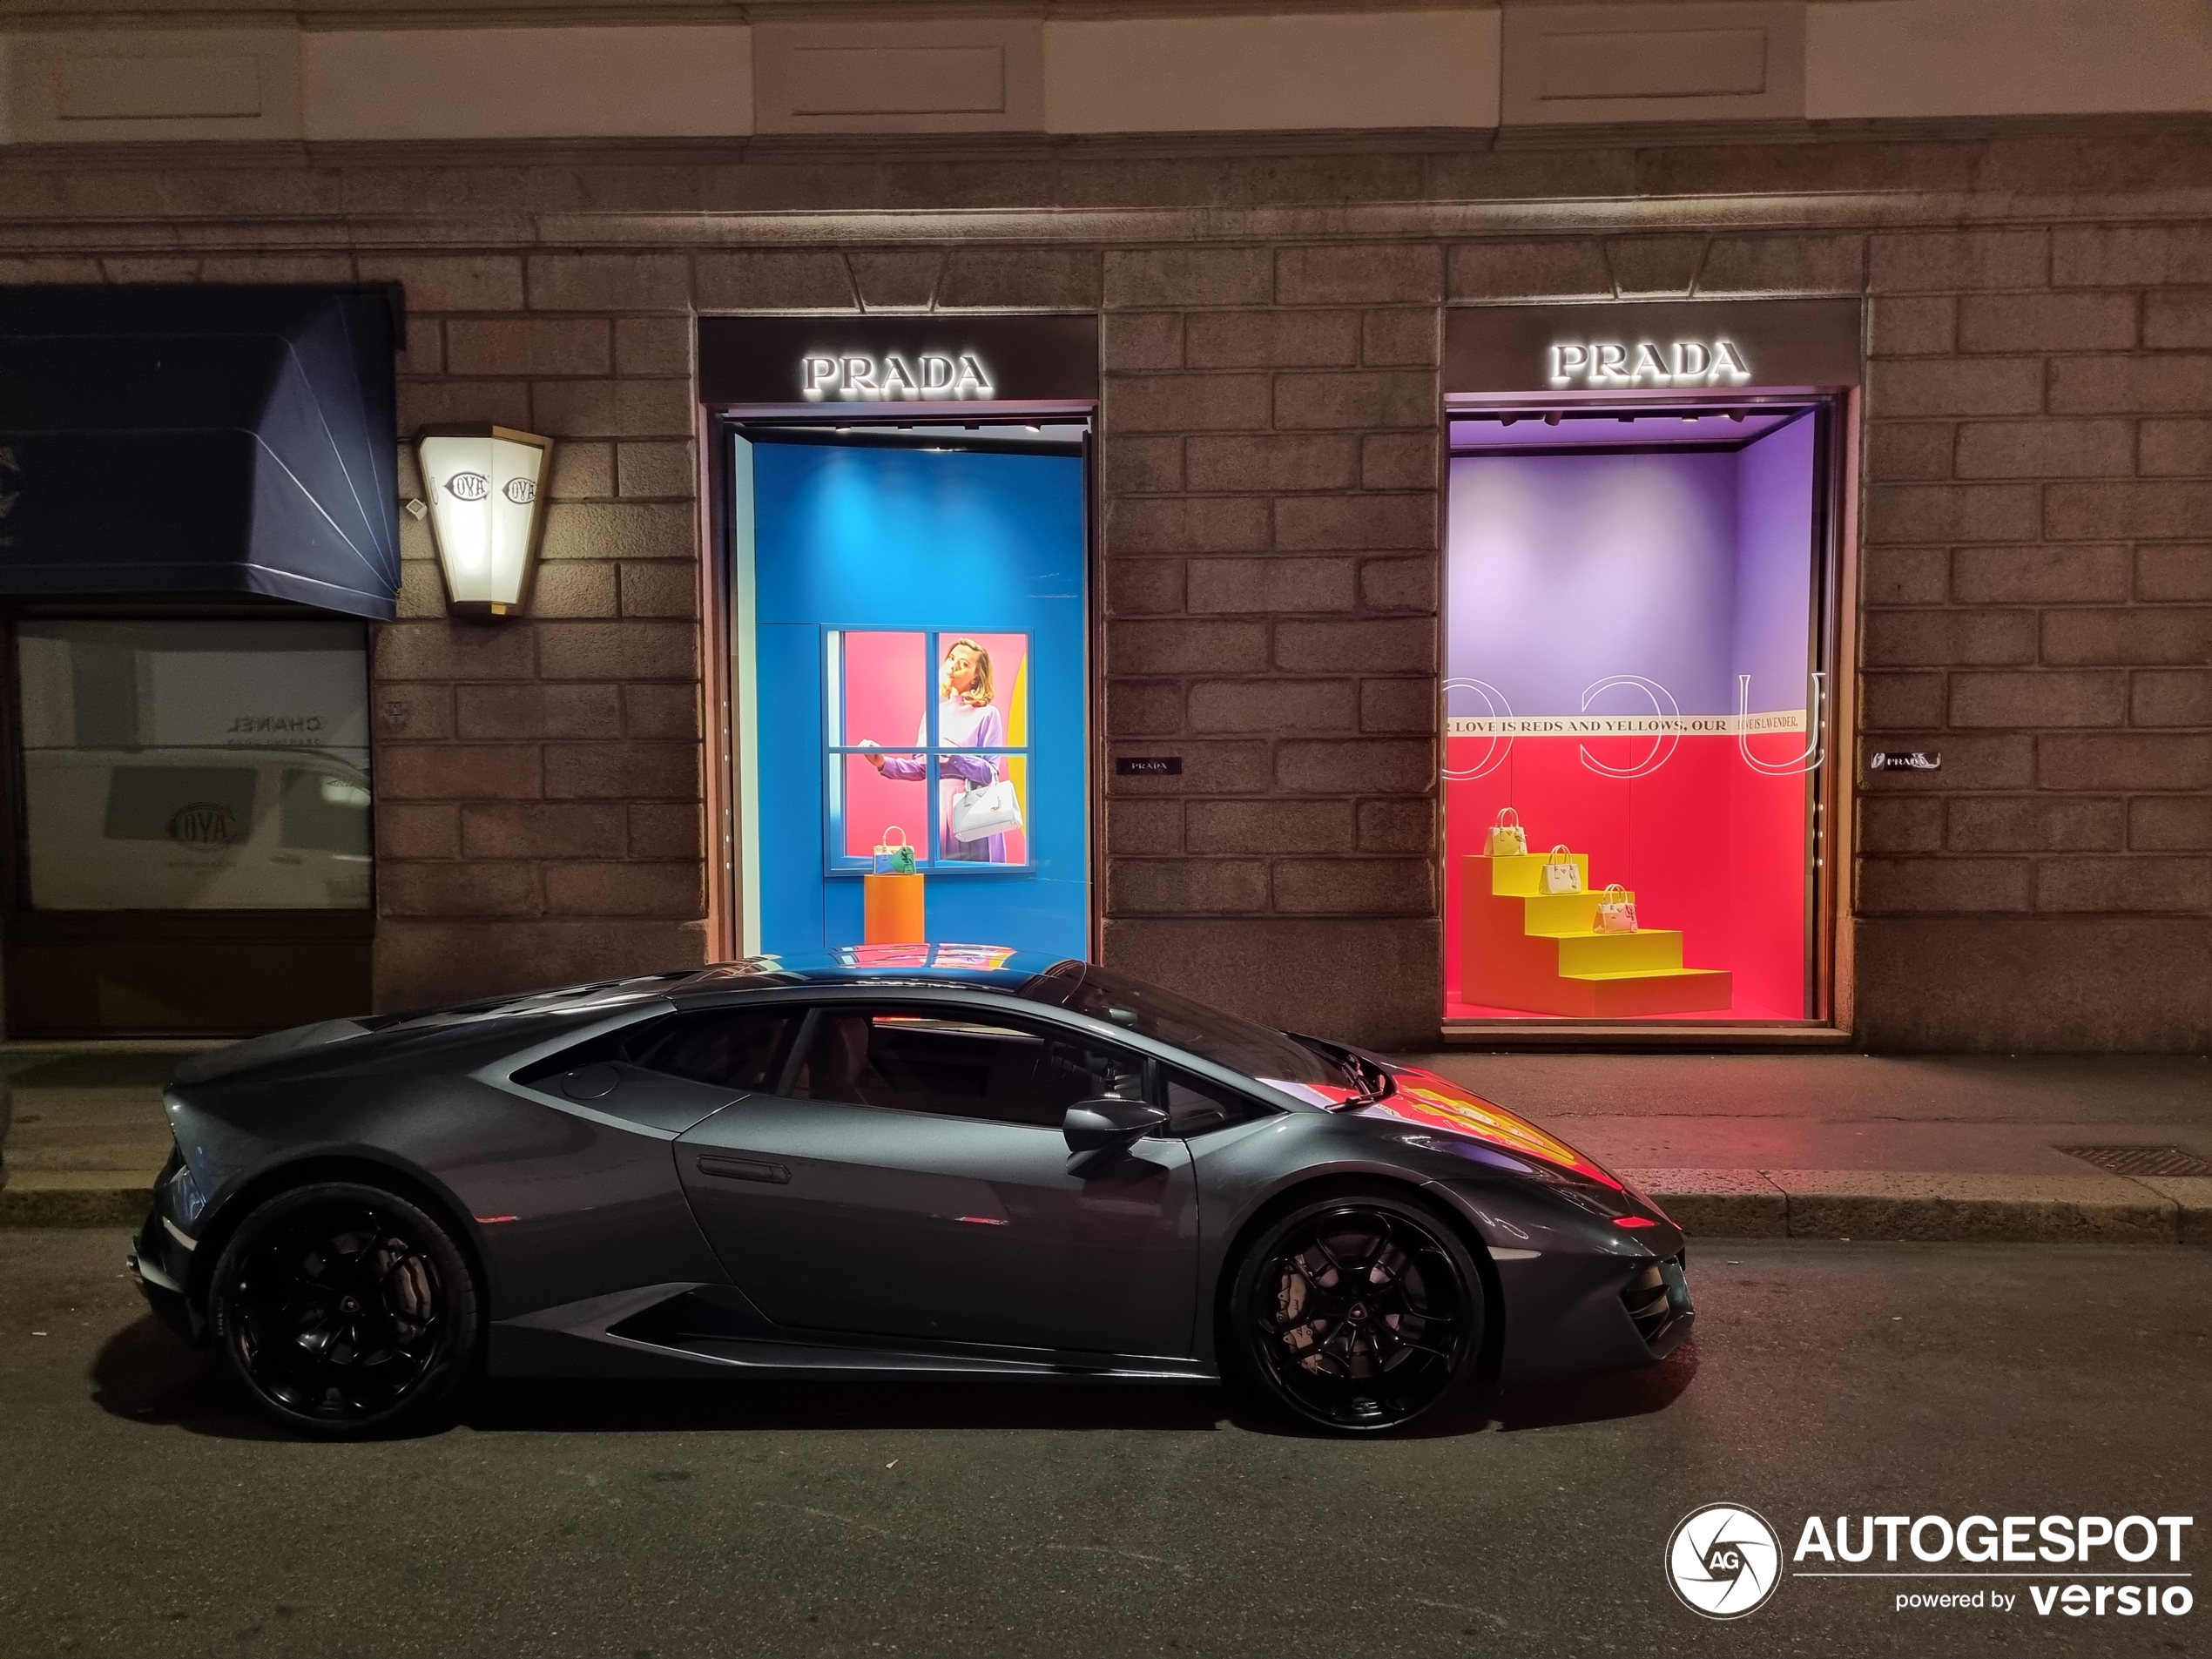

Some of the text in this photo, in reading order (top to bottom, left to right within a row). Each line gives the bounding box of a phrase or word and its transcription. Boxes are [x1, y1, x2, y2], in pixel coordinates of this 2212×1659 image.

[803, 355, 992, 392] PRADA
[1552, 342, 1750, 380] PRADA
[1456, 721, 1496, 732] LOVE
[1501, 721, 1517, 732] IS
[1521, 721, 1563, 732] REDS
[1567, 721, 1601, 732] AND
[1605, 720, 1688, 732] YELLOWS,
[1691, 720, 1727, 731] OUR
[1762, 716, 1798, 729] LAVENDER,
